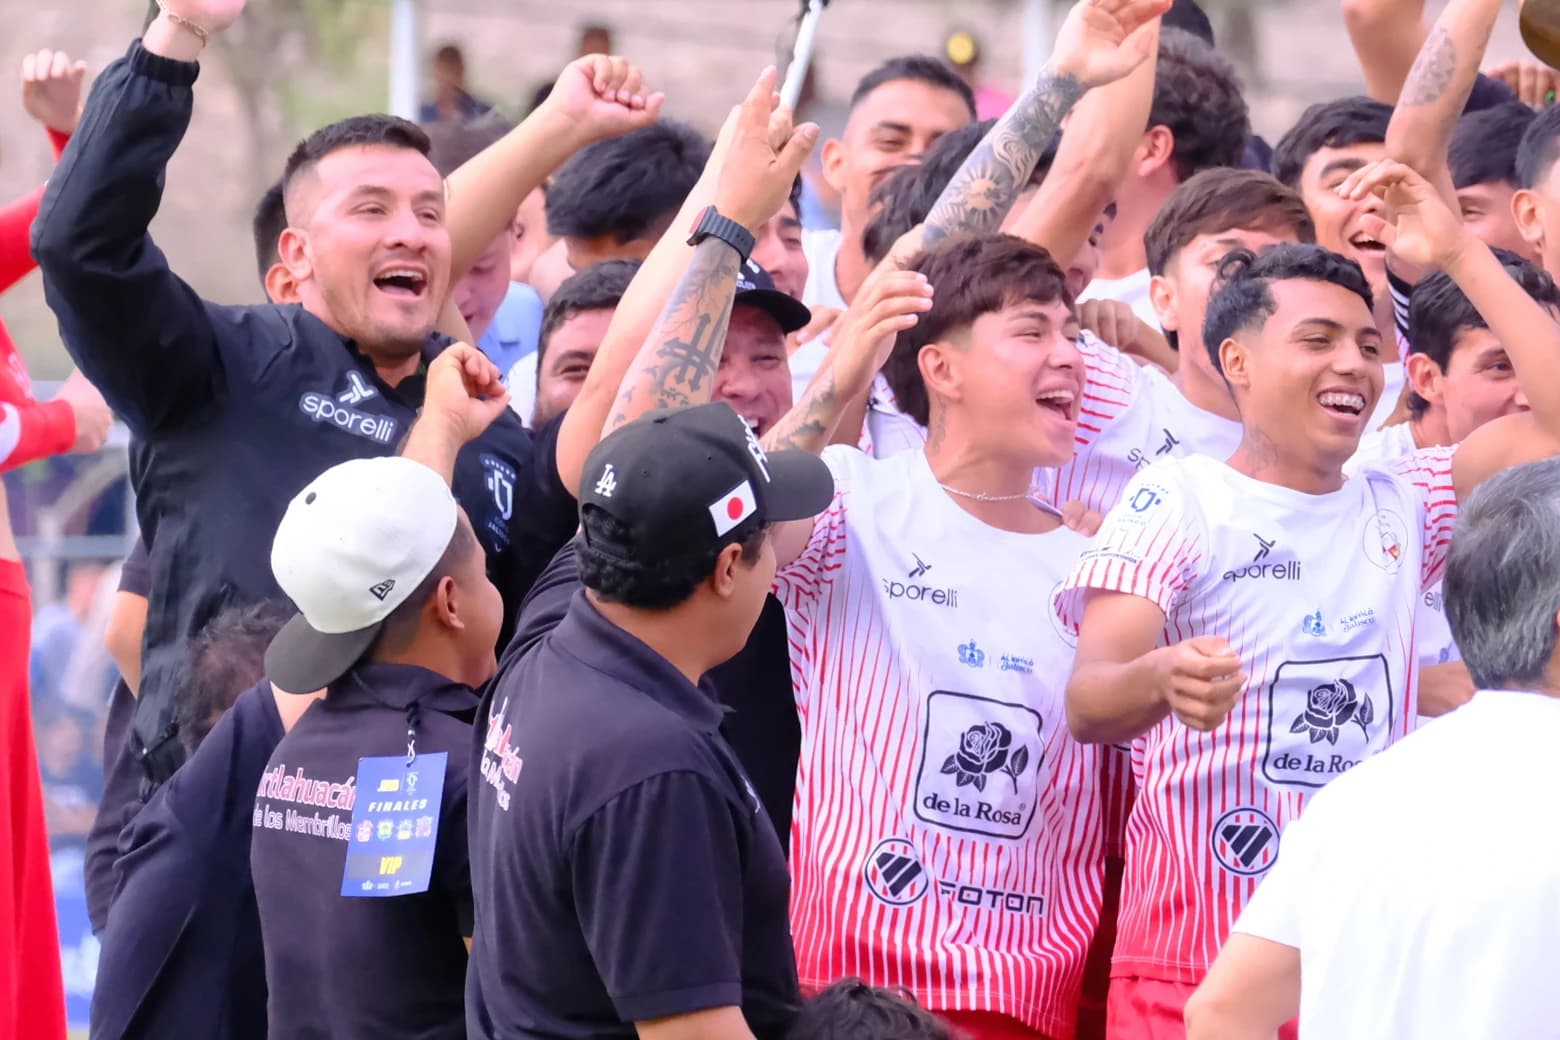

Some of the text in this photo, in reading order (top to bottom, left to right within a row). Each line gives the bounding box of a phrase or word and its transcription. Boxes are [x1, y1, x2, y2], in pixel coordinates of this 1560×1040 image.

[302, 393, 394, 442] sporelli
[595, 463, 617, 498] LA
[1273, 752, 1364, 773] de la Ro
[264, 804, 283, 830] los
[368, 798, 429, 813] FINALES
[922, 792, 1022, 826] de la Rosa
[379, 856, 403, 875] VIP
[938, 879, 1044, 916] FOTON
